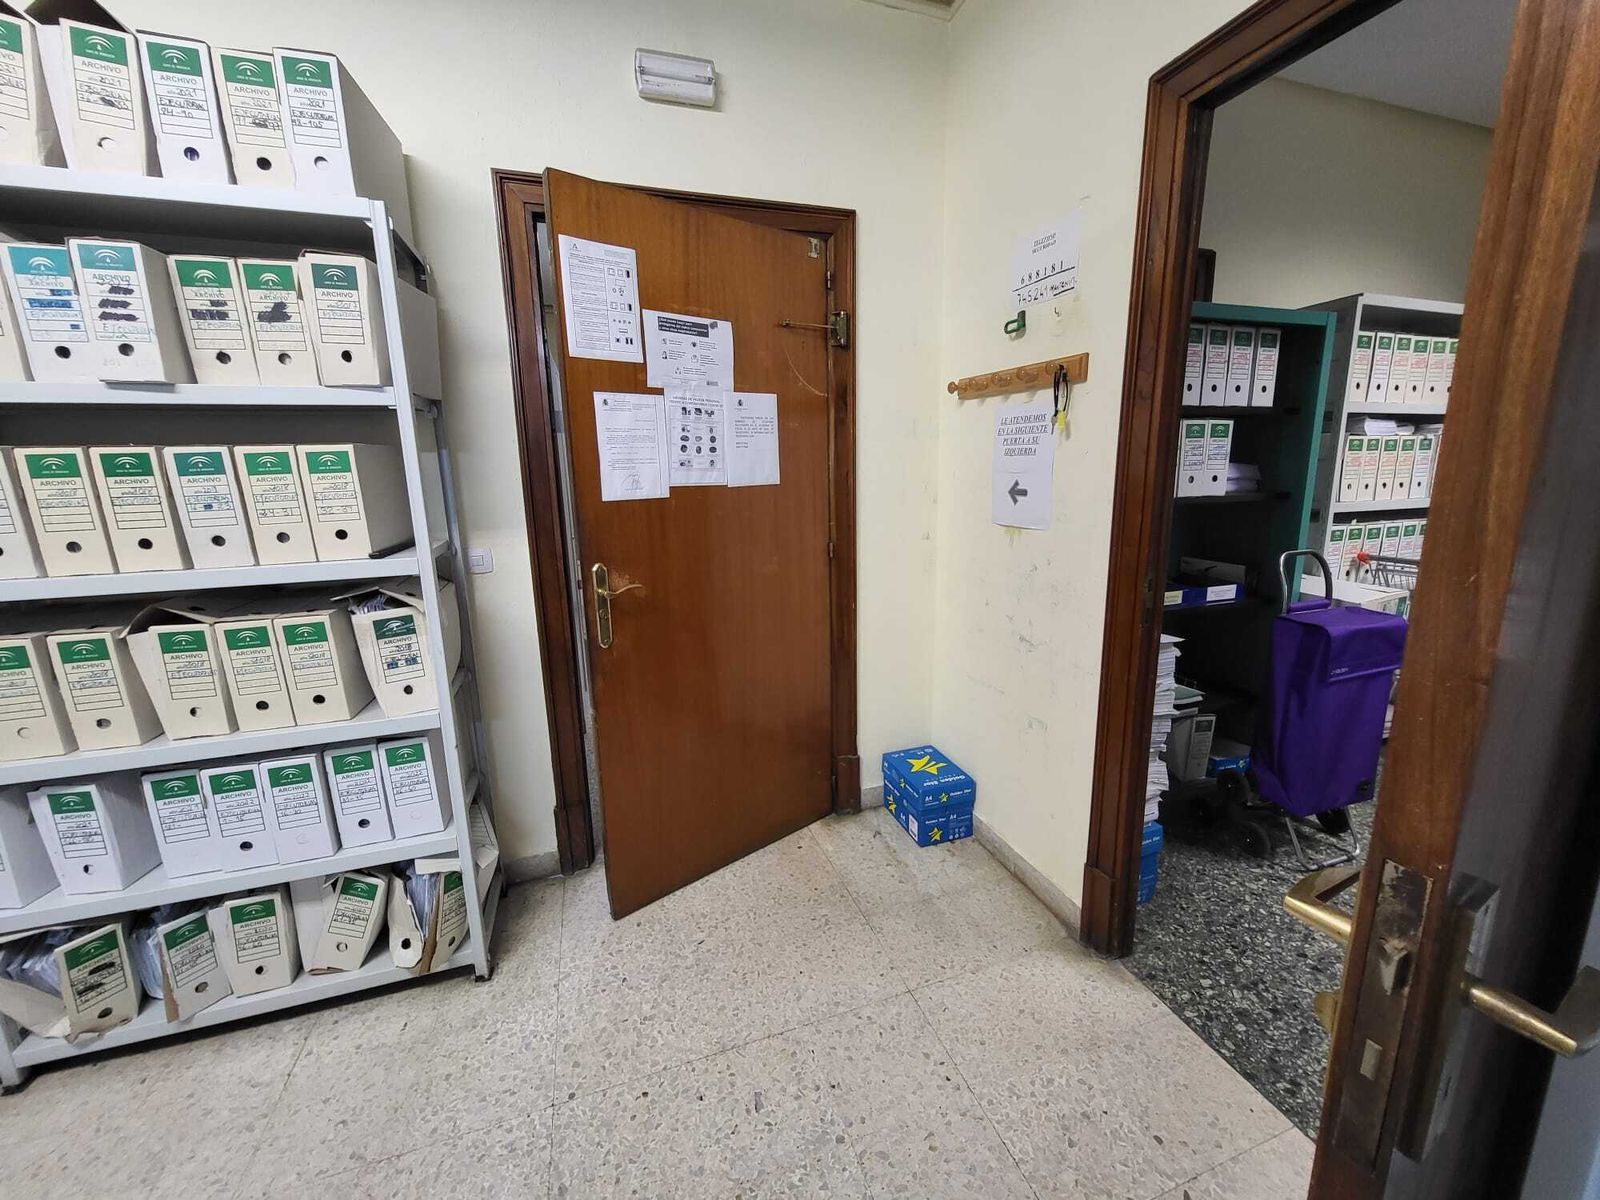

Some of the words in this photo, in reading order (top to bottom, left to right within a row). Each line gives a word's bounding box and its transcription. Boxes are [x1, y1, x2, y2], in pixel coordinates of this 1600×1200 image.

[80, 58, 121, 74] ARCHIVO
[158, 73, 197, 85] ARCHIVO
[233, 84, 270, 97] ARCHIVO
[292, 85, 327, 97] ARCHIVO
[320, 290, 354, 298] ARCHIVO
[1001, 416, 1009, 426] LE
[1009, 413, 1048, 425] ATENDEMOS
[997, 427, 1005, 436] EN
[1013, 424, 1049, 435] SIGUIENTE
[1002, 436, 1025, 446] PUERTA
[1031, 435, 1041, 445] SU
[1003, 446, 1038, 457] IZQUIERDA
[38, 478, 77, 486] ARCHIVO
[112, 477, 149, 485] ARCHIVO
[186, 476, 222, 484] ARCHIVO
[254, 475, 288, 483] ARCHIVO
[315, 473, 347, 481] ARCHIVO
[382, 635, 412, 646] ARCHIVO
[234, 647, 267, 656] ARCHIVO
[293, 643, 324, 652] ARCHIVO
[169, 652, 203, 660] ARCHIVO
[70, 661, 106, 670] ARCHIVO
[393, 762, 422, 772] ARCHIVO
[340, 770, 370, 780] ARCHIVO
[277, 783, 309, 793] ARCHIVO
[219, 790, 252, 801] ARCHIVO
[162, 796, 196, 807] ARCHIVO
[59, 812, 92, 821] ARCHIVO
[343, 895, 369, 906] ARCHIVO
[238, 918, 271, 929] ARCHIVO
